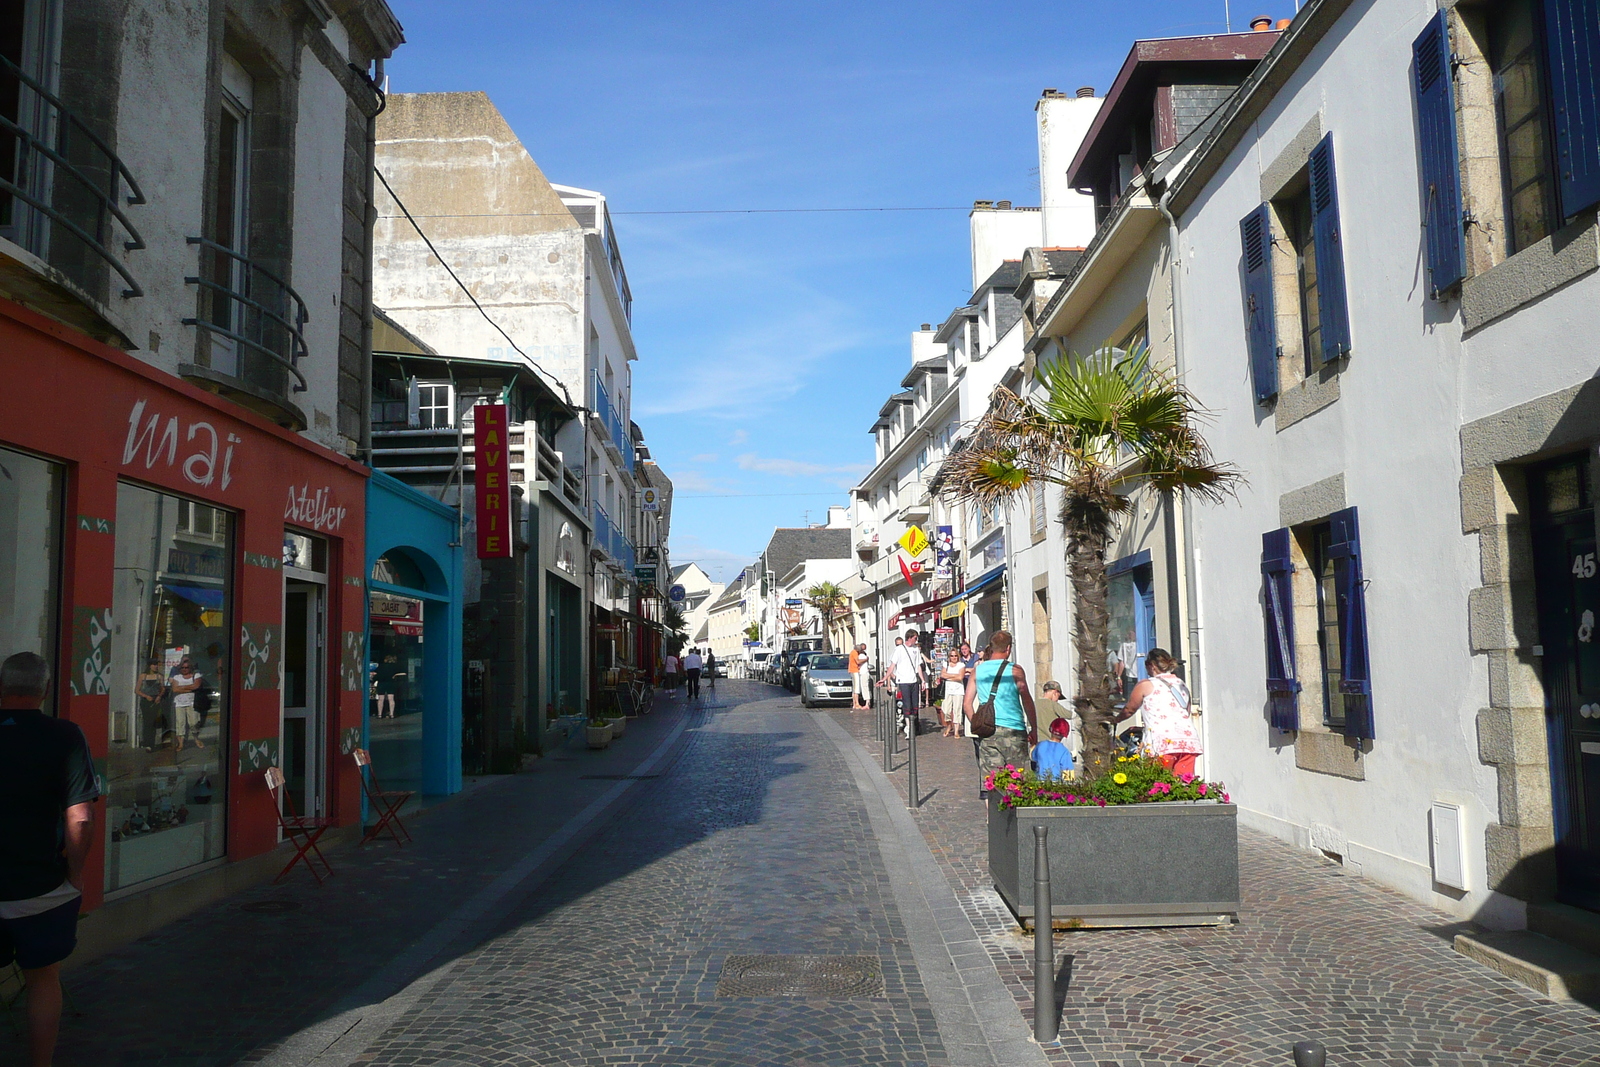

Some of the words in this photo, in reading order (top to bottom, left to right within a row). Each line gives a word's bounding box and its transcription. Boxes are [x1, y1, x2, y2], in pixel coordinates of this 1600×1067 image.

[284, 480, 346, 531] Atelier
[484, 409, 499, 552] LAVERIE
[1572, 552, 1596, 578] 45
